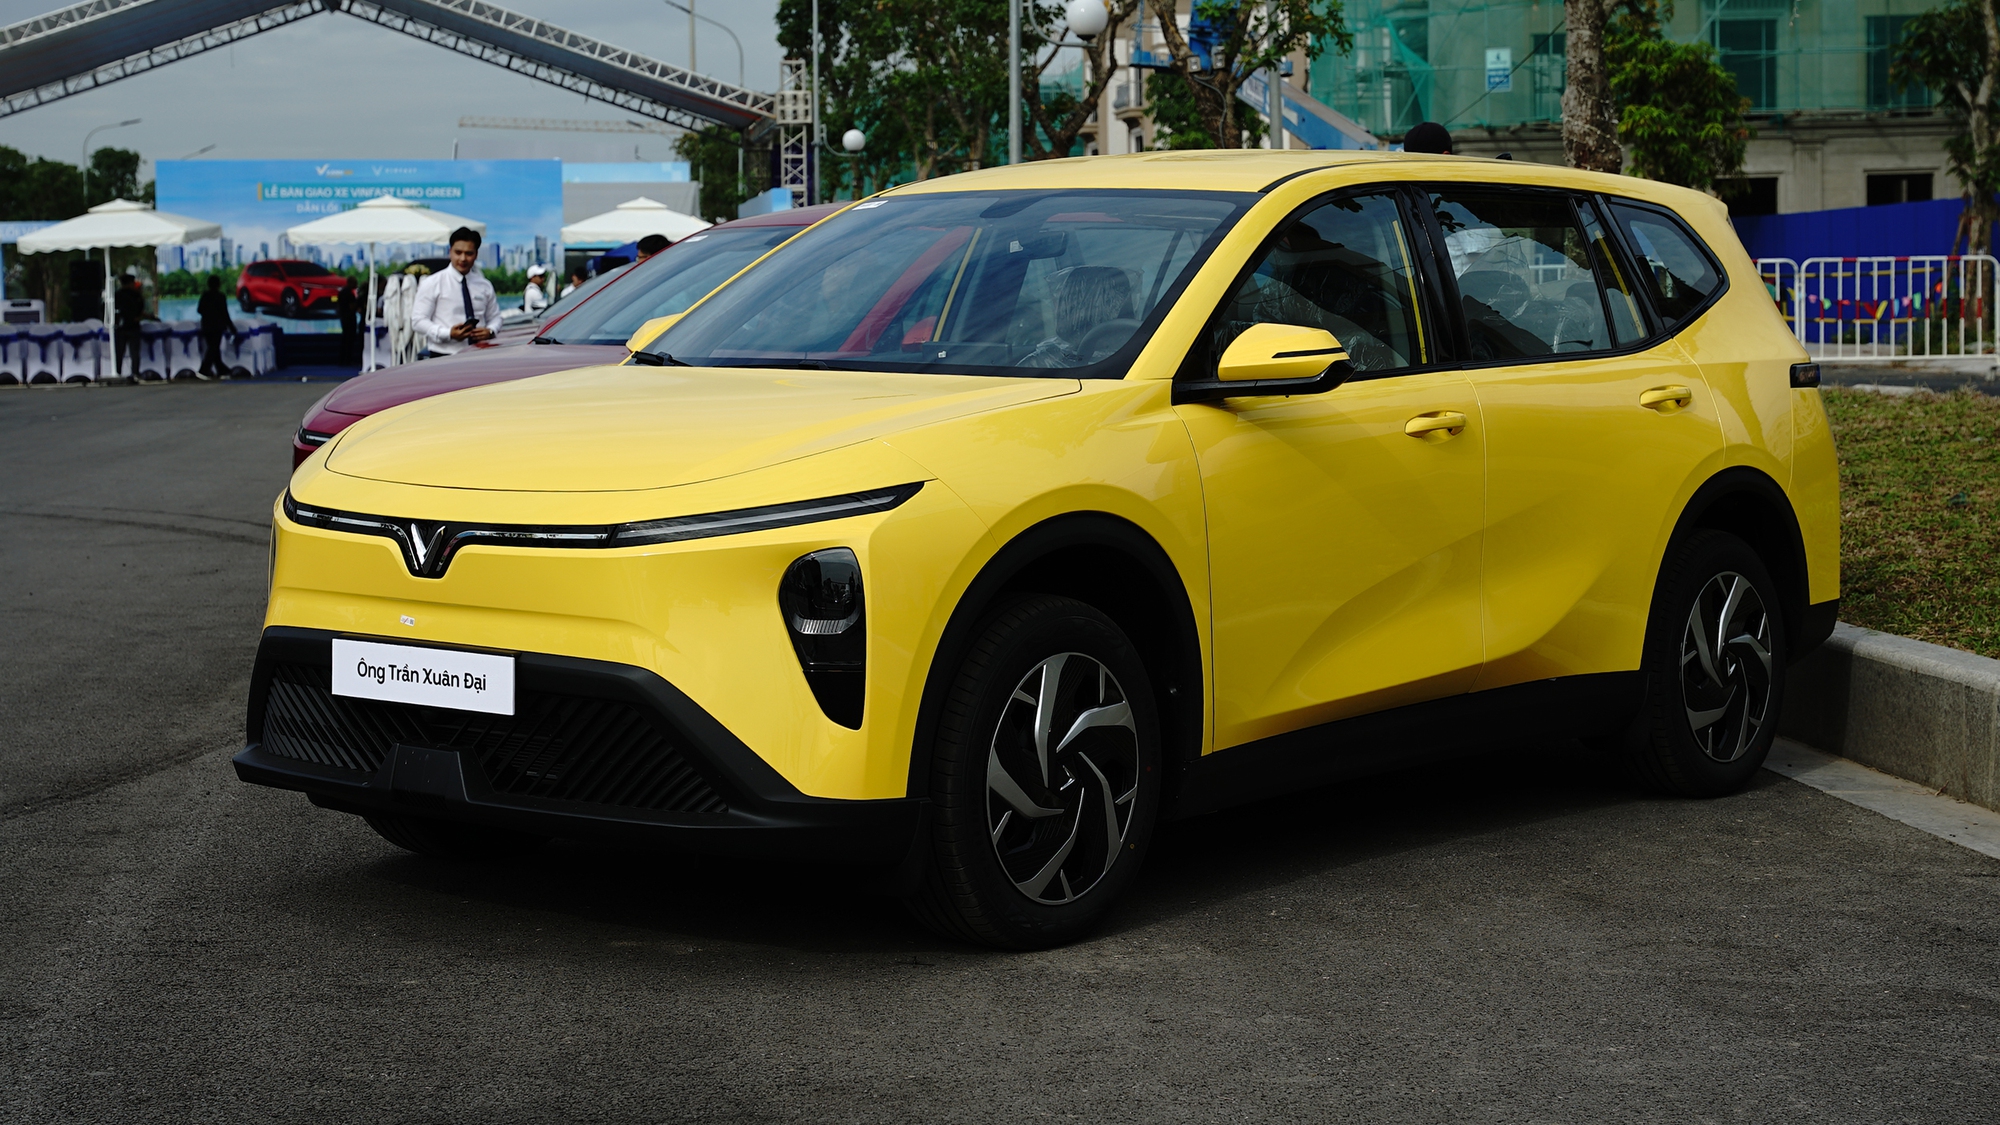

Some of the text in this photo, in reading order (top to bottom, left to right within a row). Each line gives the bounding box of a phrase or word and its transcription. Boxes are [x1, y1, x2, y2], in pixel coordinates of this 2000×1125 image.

[305, 187, 333, 199] GIAO
[334, 187, 349, 198] XE
[396, 187, 424, 198] LIMO
[425, 187, 462, 198] GREEN
[357, 657, 487, 694] Ông Trần Xuân Đại
